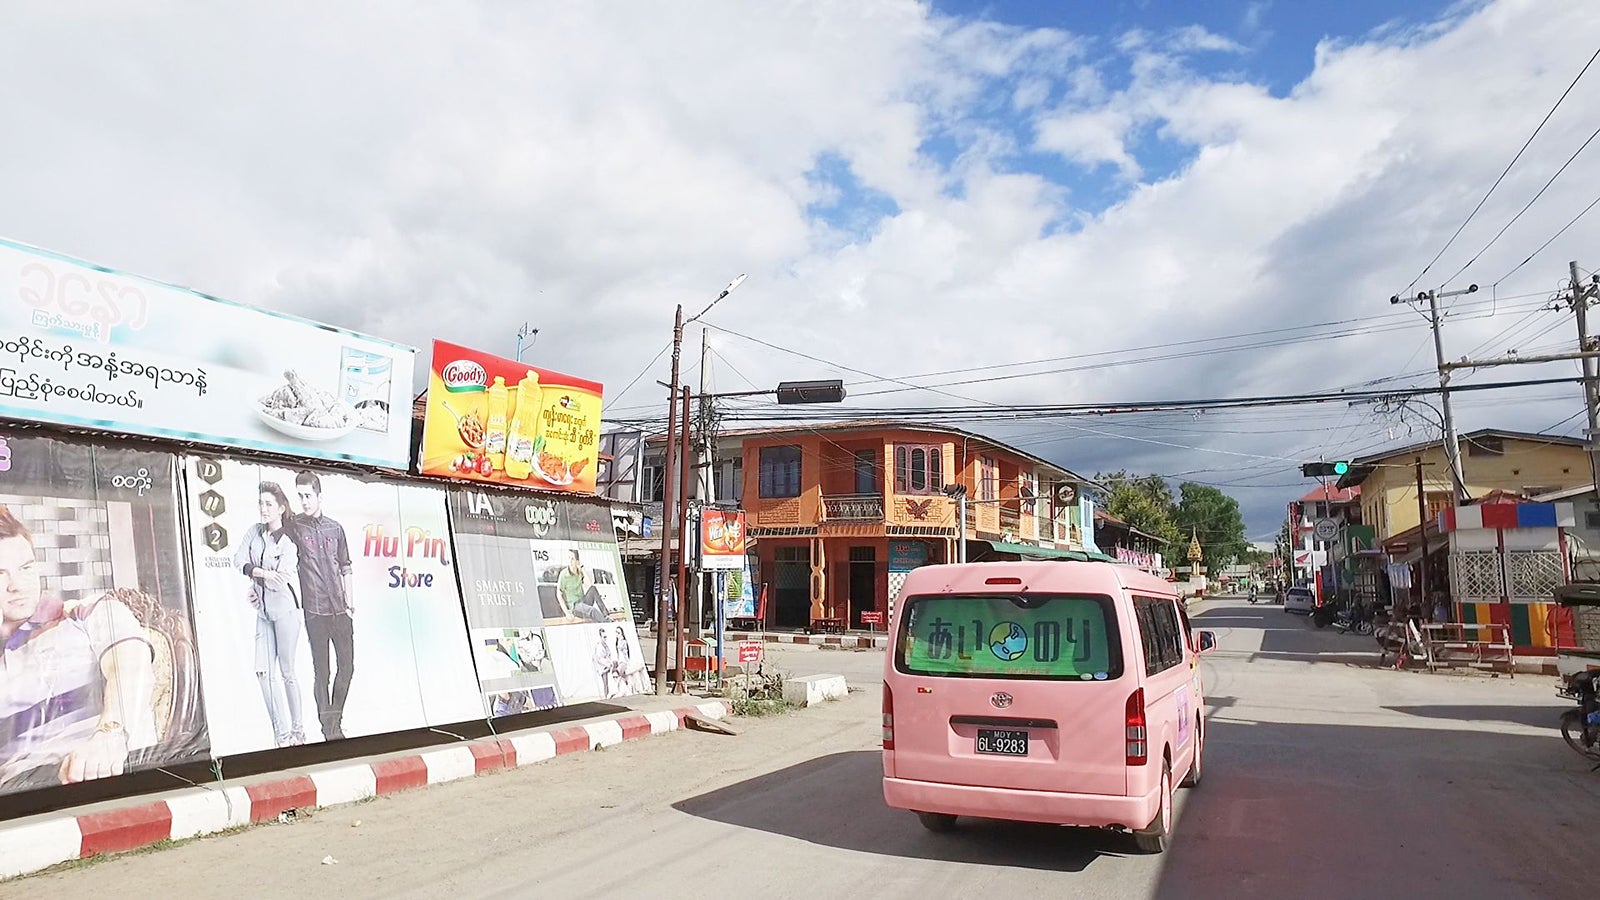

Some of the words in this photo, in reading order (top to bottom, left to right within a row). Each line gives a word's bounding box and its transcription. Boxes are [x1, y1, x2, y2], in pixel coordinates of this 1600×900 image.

[447, 366, 484, 384] Goody
[363, 524, 399, 557] Hu
[405, 526, 450, 566] Pin
[388, 566, 434, 588] Store
[475, 579, 511, 592] SMART
[515, 581, 525, 594] IS
[479, 594, 516, 606] TRUST.
[978, 737, 1025, 753] 6L-9283
